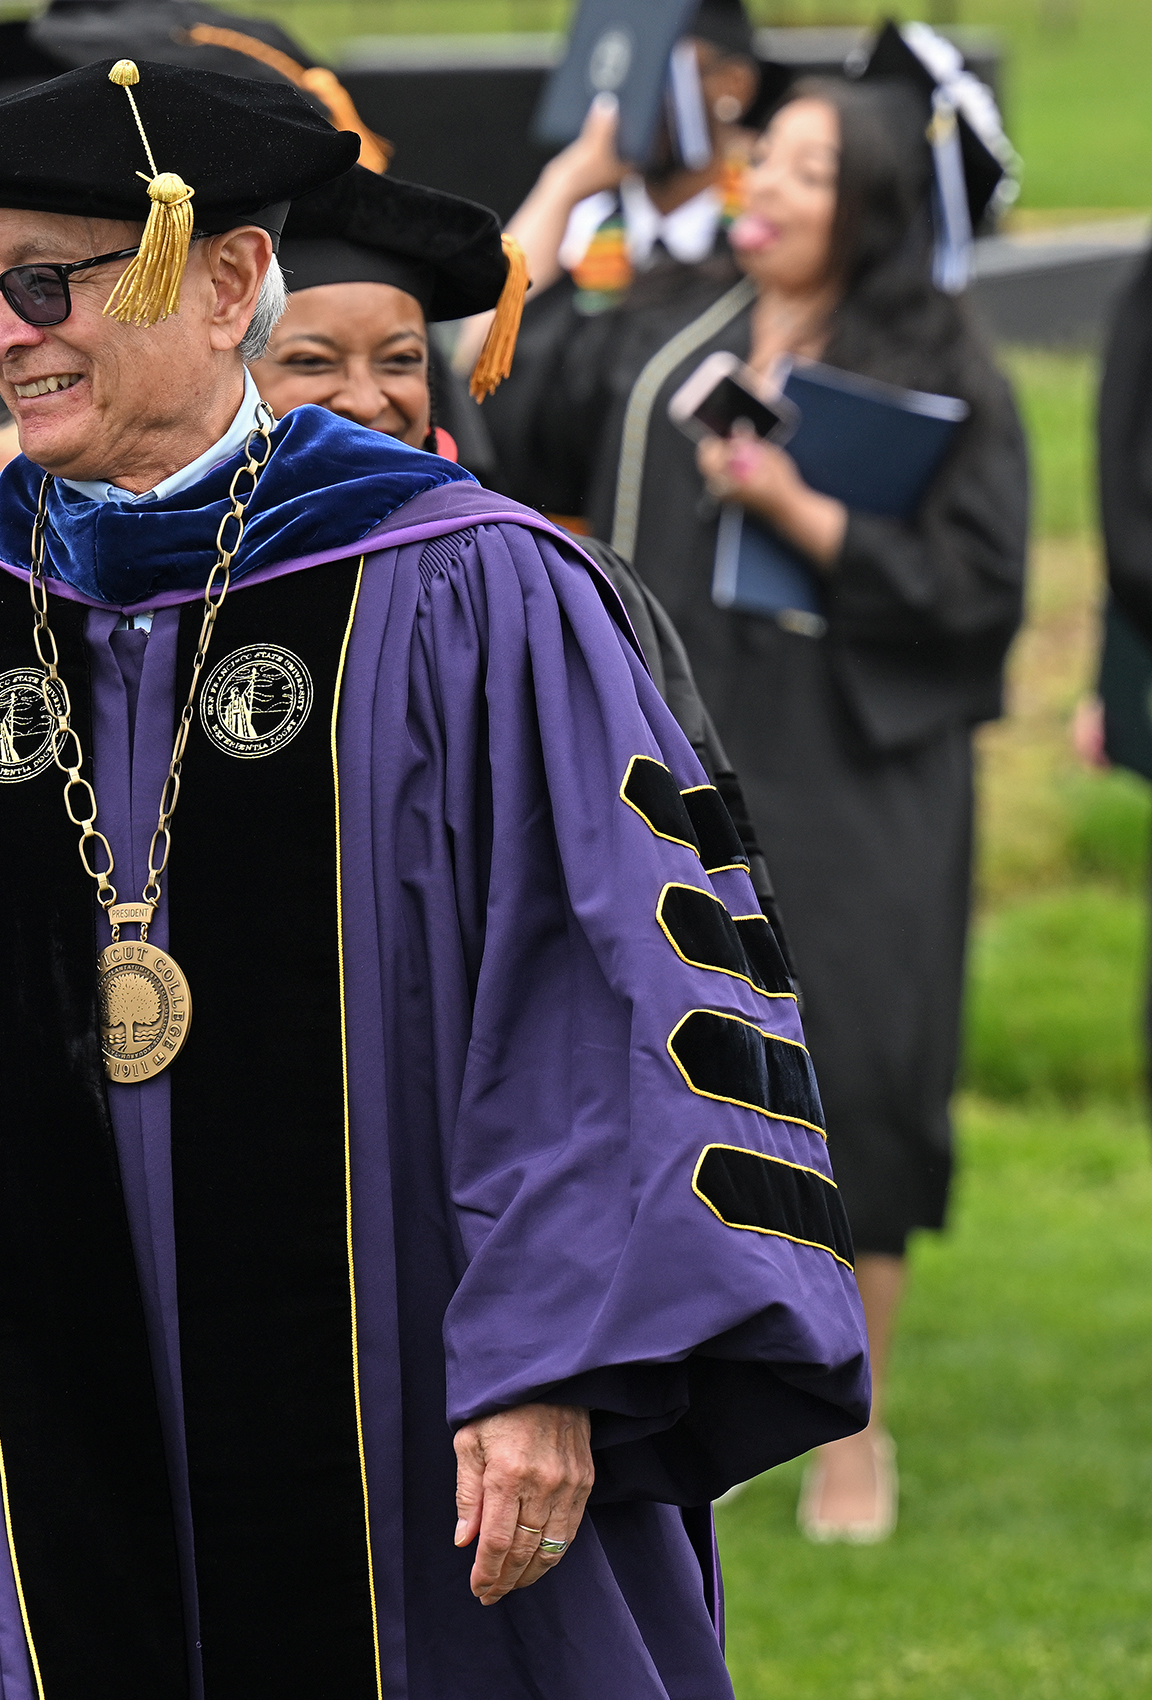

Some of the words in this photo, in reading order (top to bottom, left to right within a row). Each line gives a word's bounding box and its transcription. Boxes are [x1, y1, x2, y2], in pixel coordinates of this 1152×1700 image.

[254, 652, 283, 662] STATE
[13, 675, 39, 684] STATE
[111, 909, 149, 918] PRESIDENT
[153, 957, 184, 1051] COLLEGE
[114, 1061, 149, 1077] 1911
